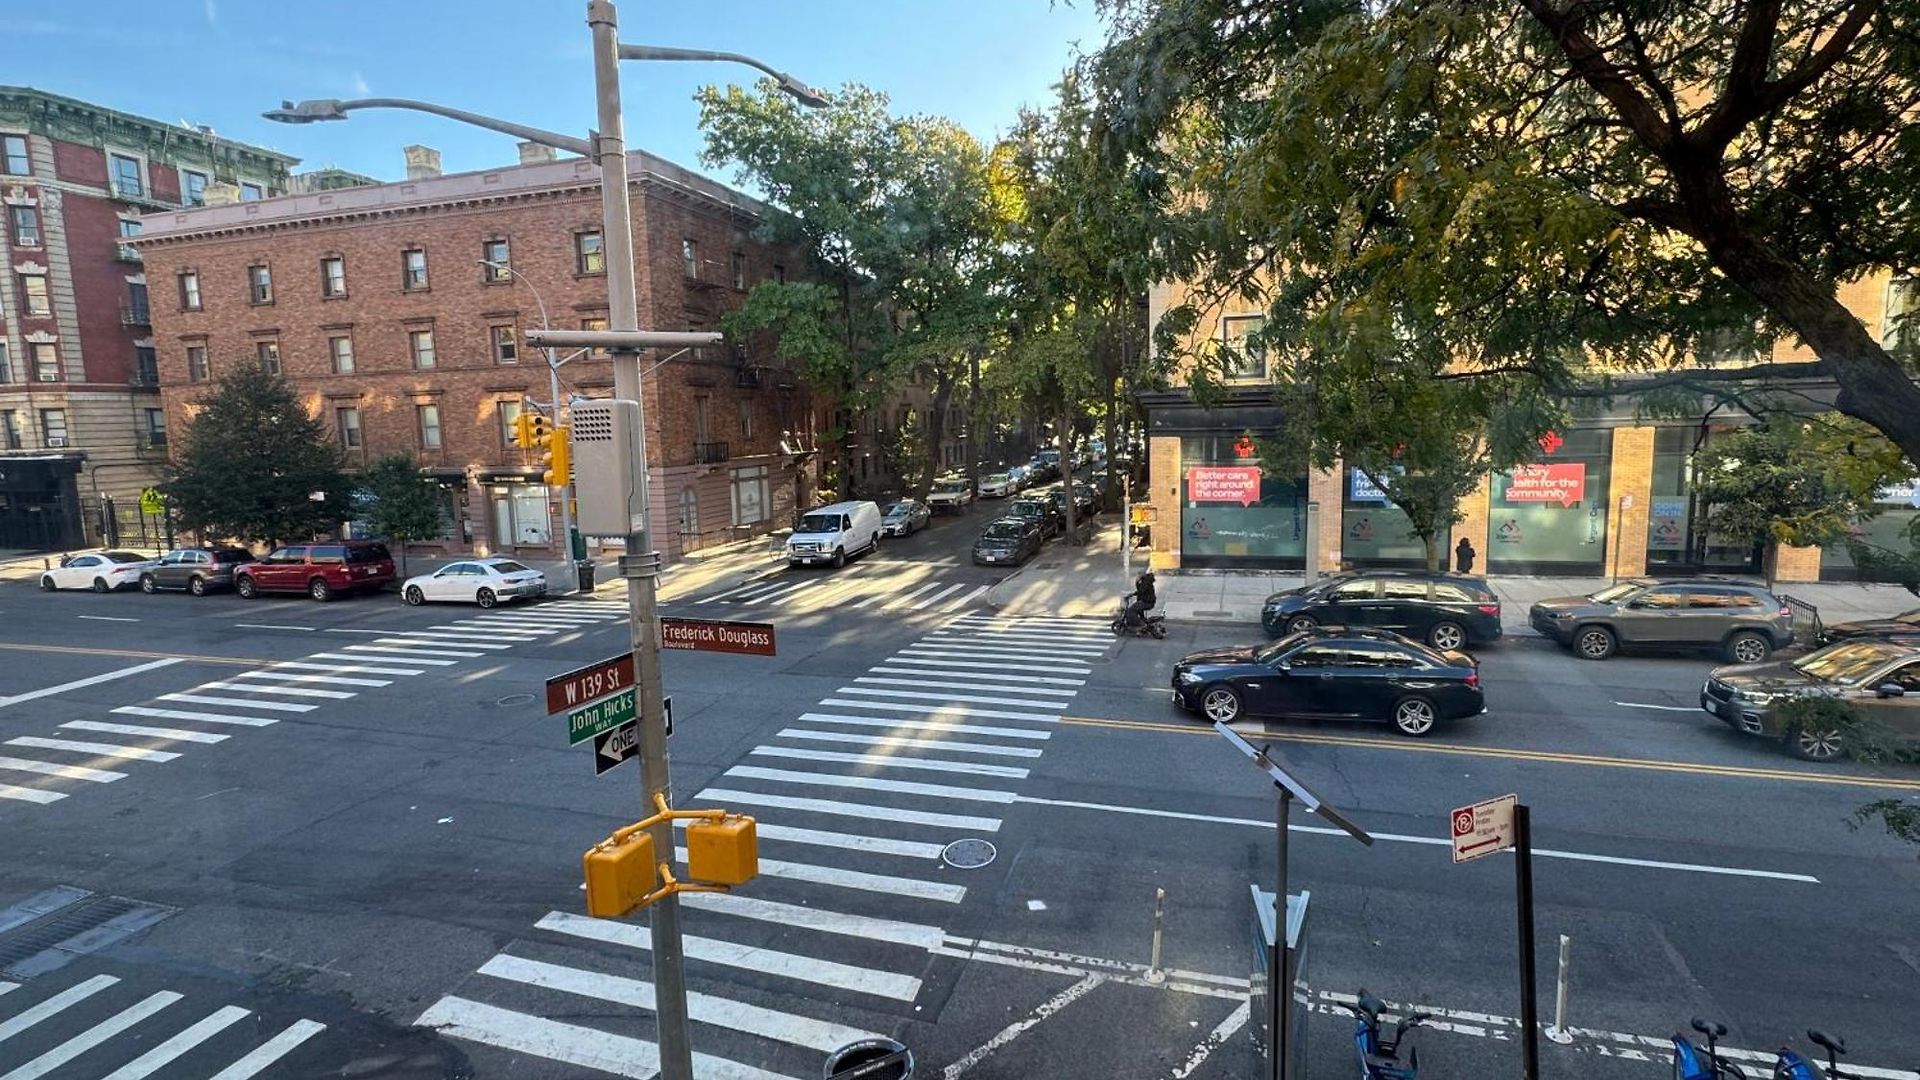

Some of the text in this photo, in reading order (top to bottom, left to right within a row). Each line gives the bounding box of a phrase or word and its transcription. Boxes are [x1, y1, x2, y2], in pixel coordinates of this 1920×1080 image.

[1196, 471, 1226, 479] Better
[1541, 477, 1558, 487] for
[1560, 478, 1579, 487] the
[1196, 480, 1253, 490] right around
[1355, 488, 1385, 496] docto
[663, 624, 769, 648] Frederick Douglass
[565, 667, 620, 705] W 139 St
[571, 695, 633, 733] John Hicks
[594, 718, 613, 732] WAY
[612, 729, 634, 753] ONE
